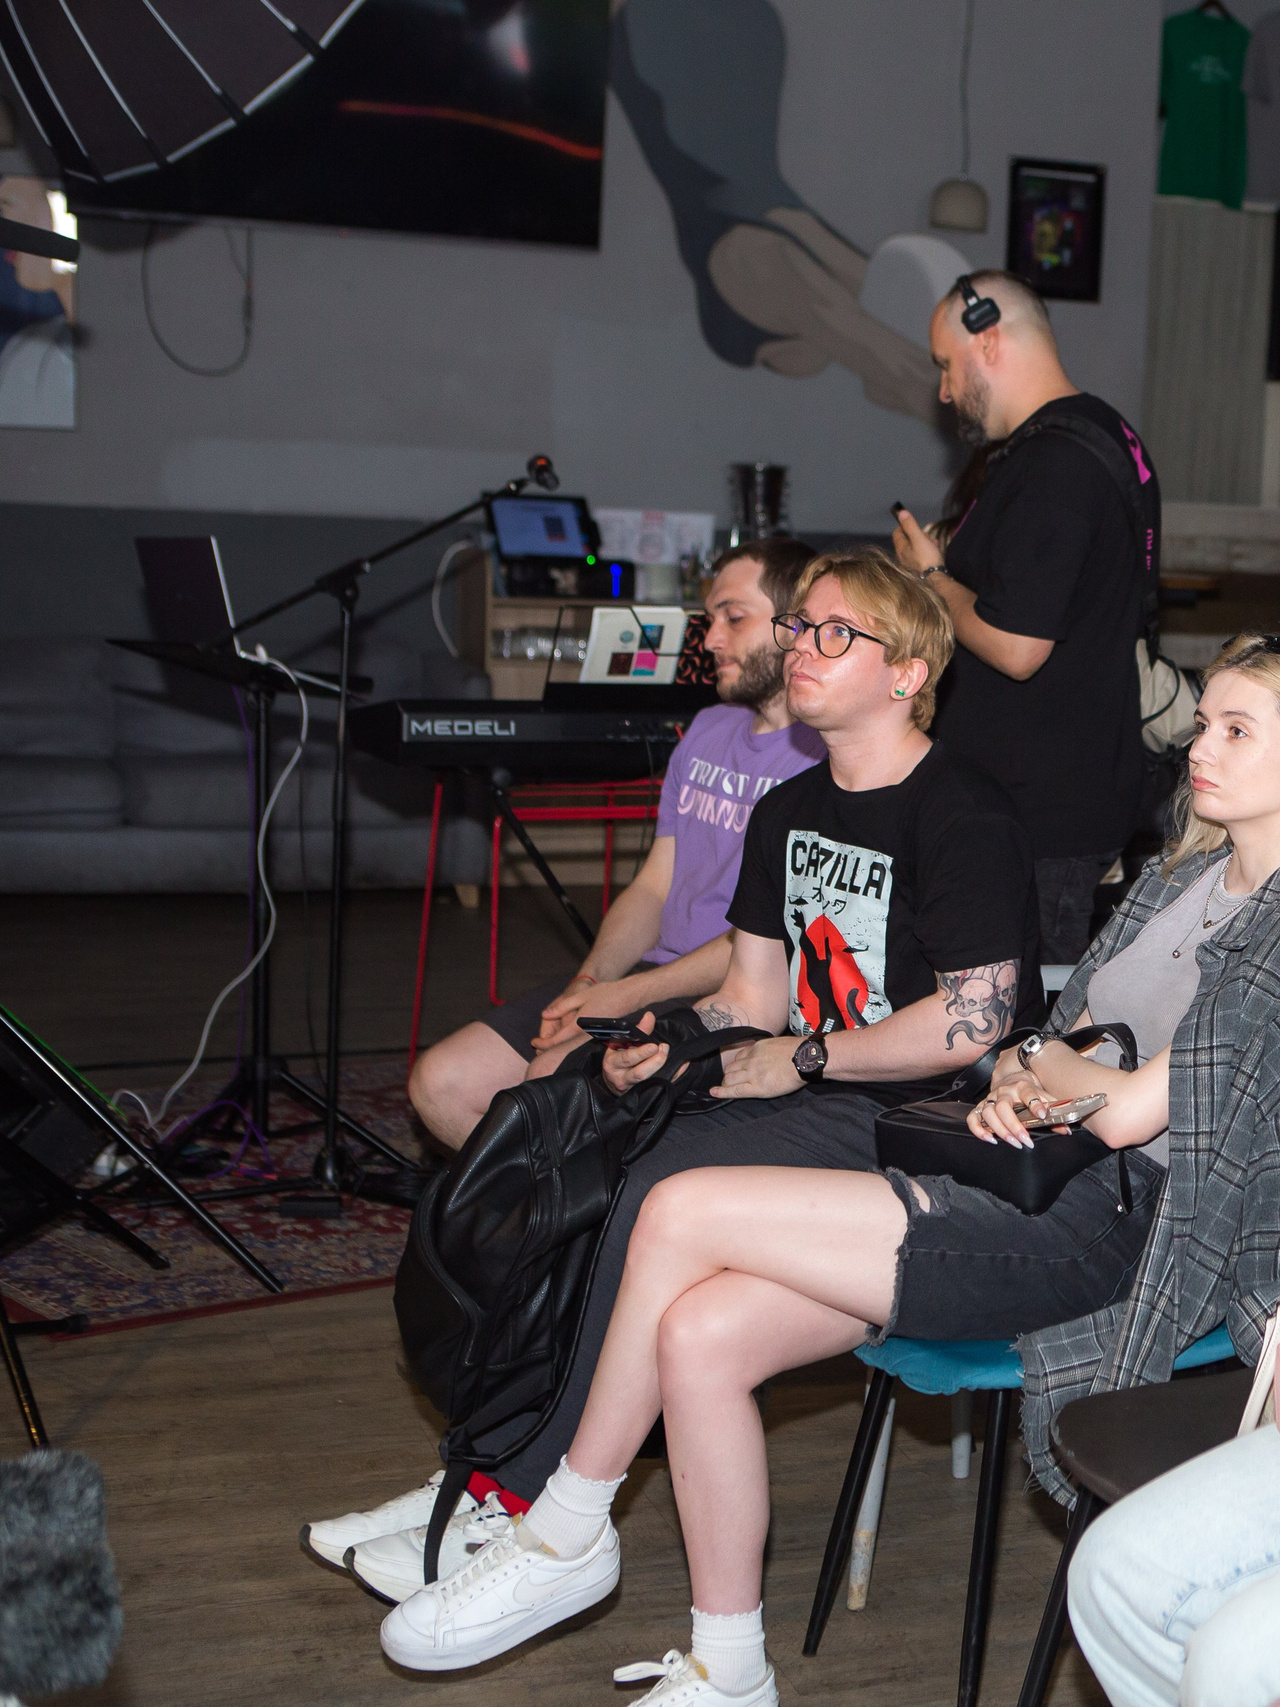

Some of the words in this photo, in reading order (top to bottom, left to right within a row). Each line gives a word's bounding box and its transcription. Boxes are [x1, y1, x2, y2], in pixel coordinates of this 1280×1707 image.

[410, 719, 516, 736] MEDELI
[689, 757, 751, 799] TRUST
[677, 784, 755, 834] UNKNO
